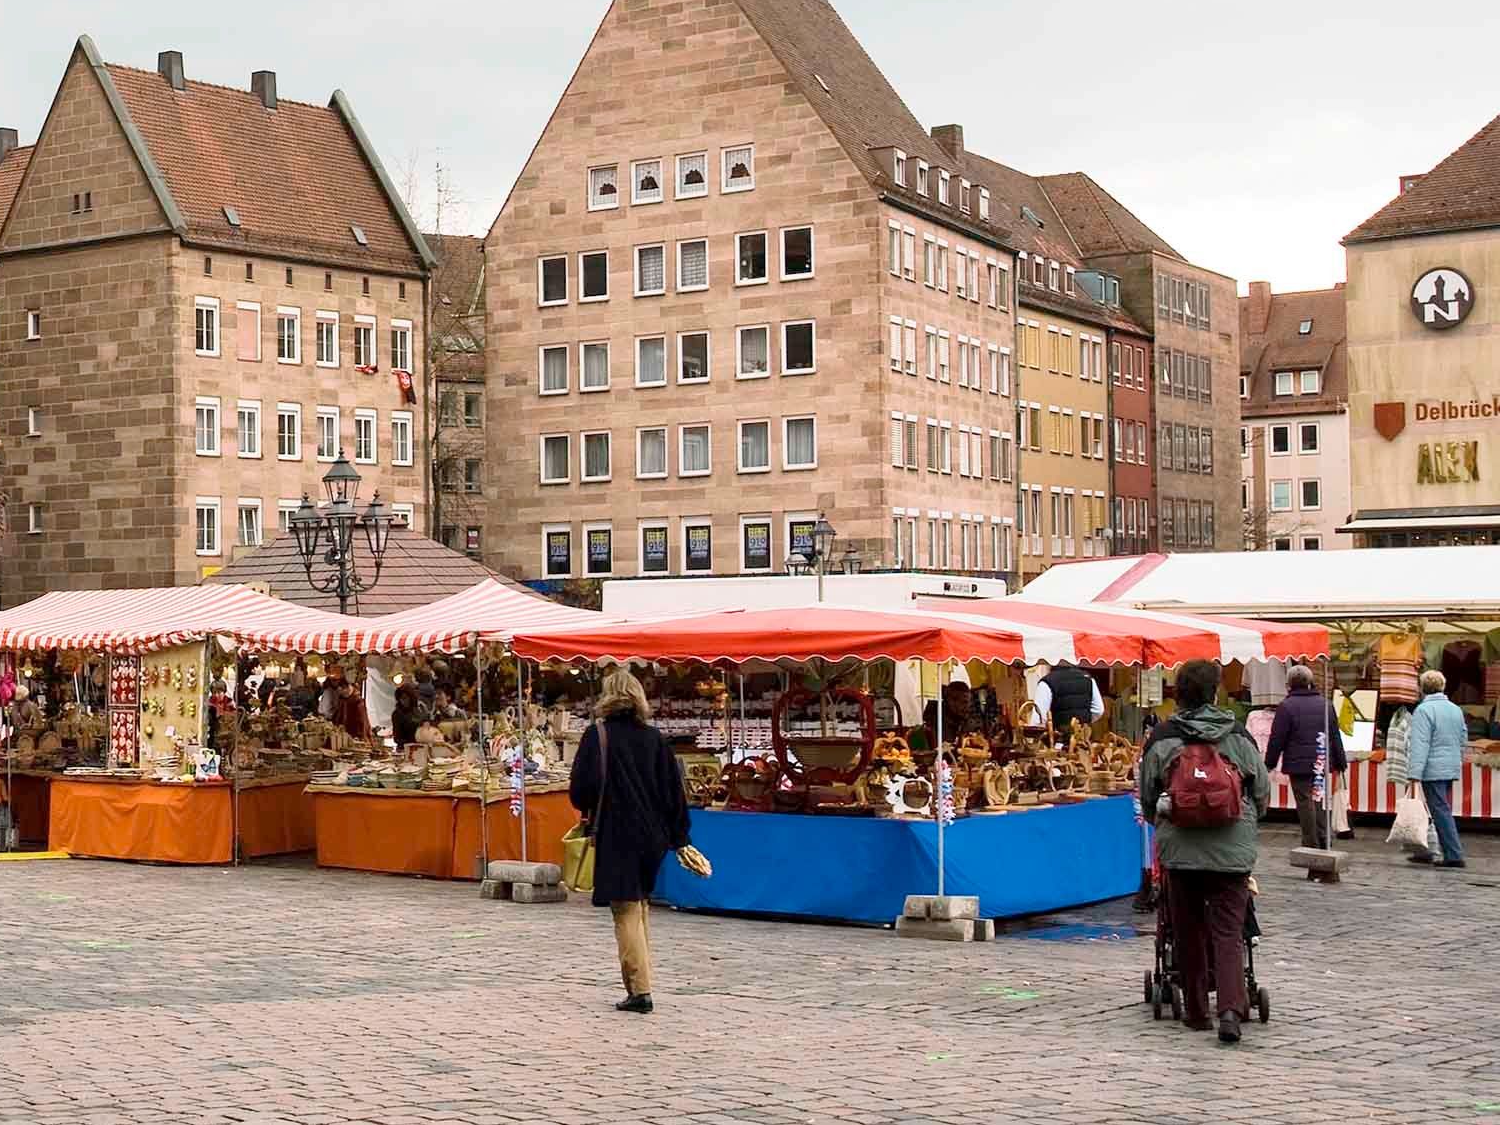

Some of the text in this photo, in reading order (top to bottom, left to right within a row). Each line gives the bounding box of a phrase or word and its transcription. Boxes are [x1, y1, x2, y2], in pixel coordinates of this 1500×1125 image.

[1424, 301, 1460, 323] N
[1415, 397, 1500, 421] Delbrück
[1417, 440, 1480, 484] ALEX
